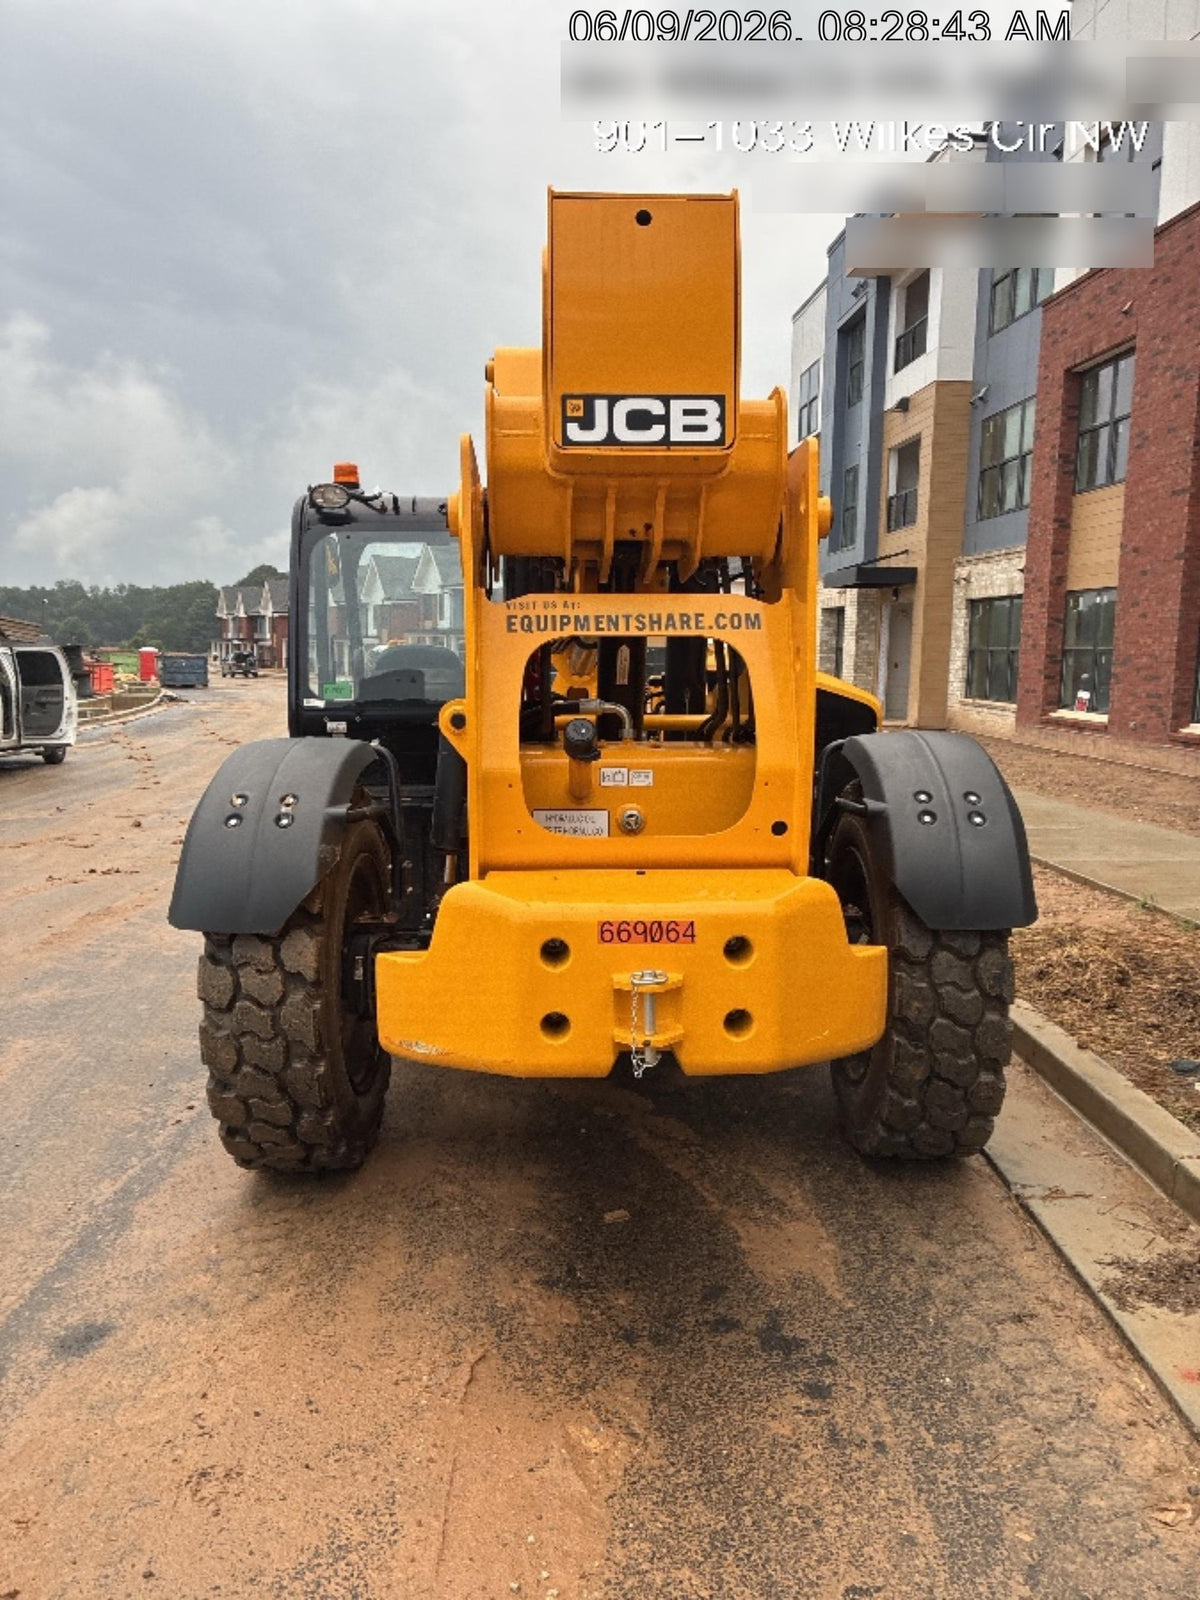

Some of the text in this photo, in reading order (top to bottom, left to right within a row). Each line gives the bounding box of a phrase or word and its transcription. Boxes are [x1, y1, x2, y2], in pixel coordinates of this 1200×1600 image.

[566, 398, 722, 442] JCB
[506, 601, 536, 610] VISIT
[543, 600, 557, 609] US
[506, 612, 762, 633] EQUIPMENTSHARE.COM
[600, 920, 696, 943] 669064
